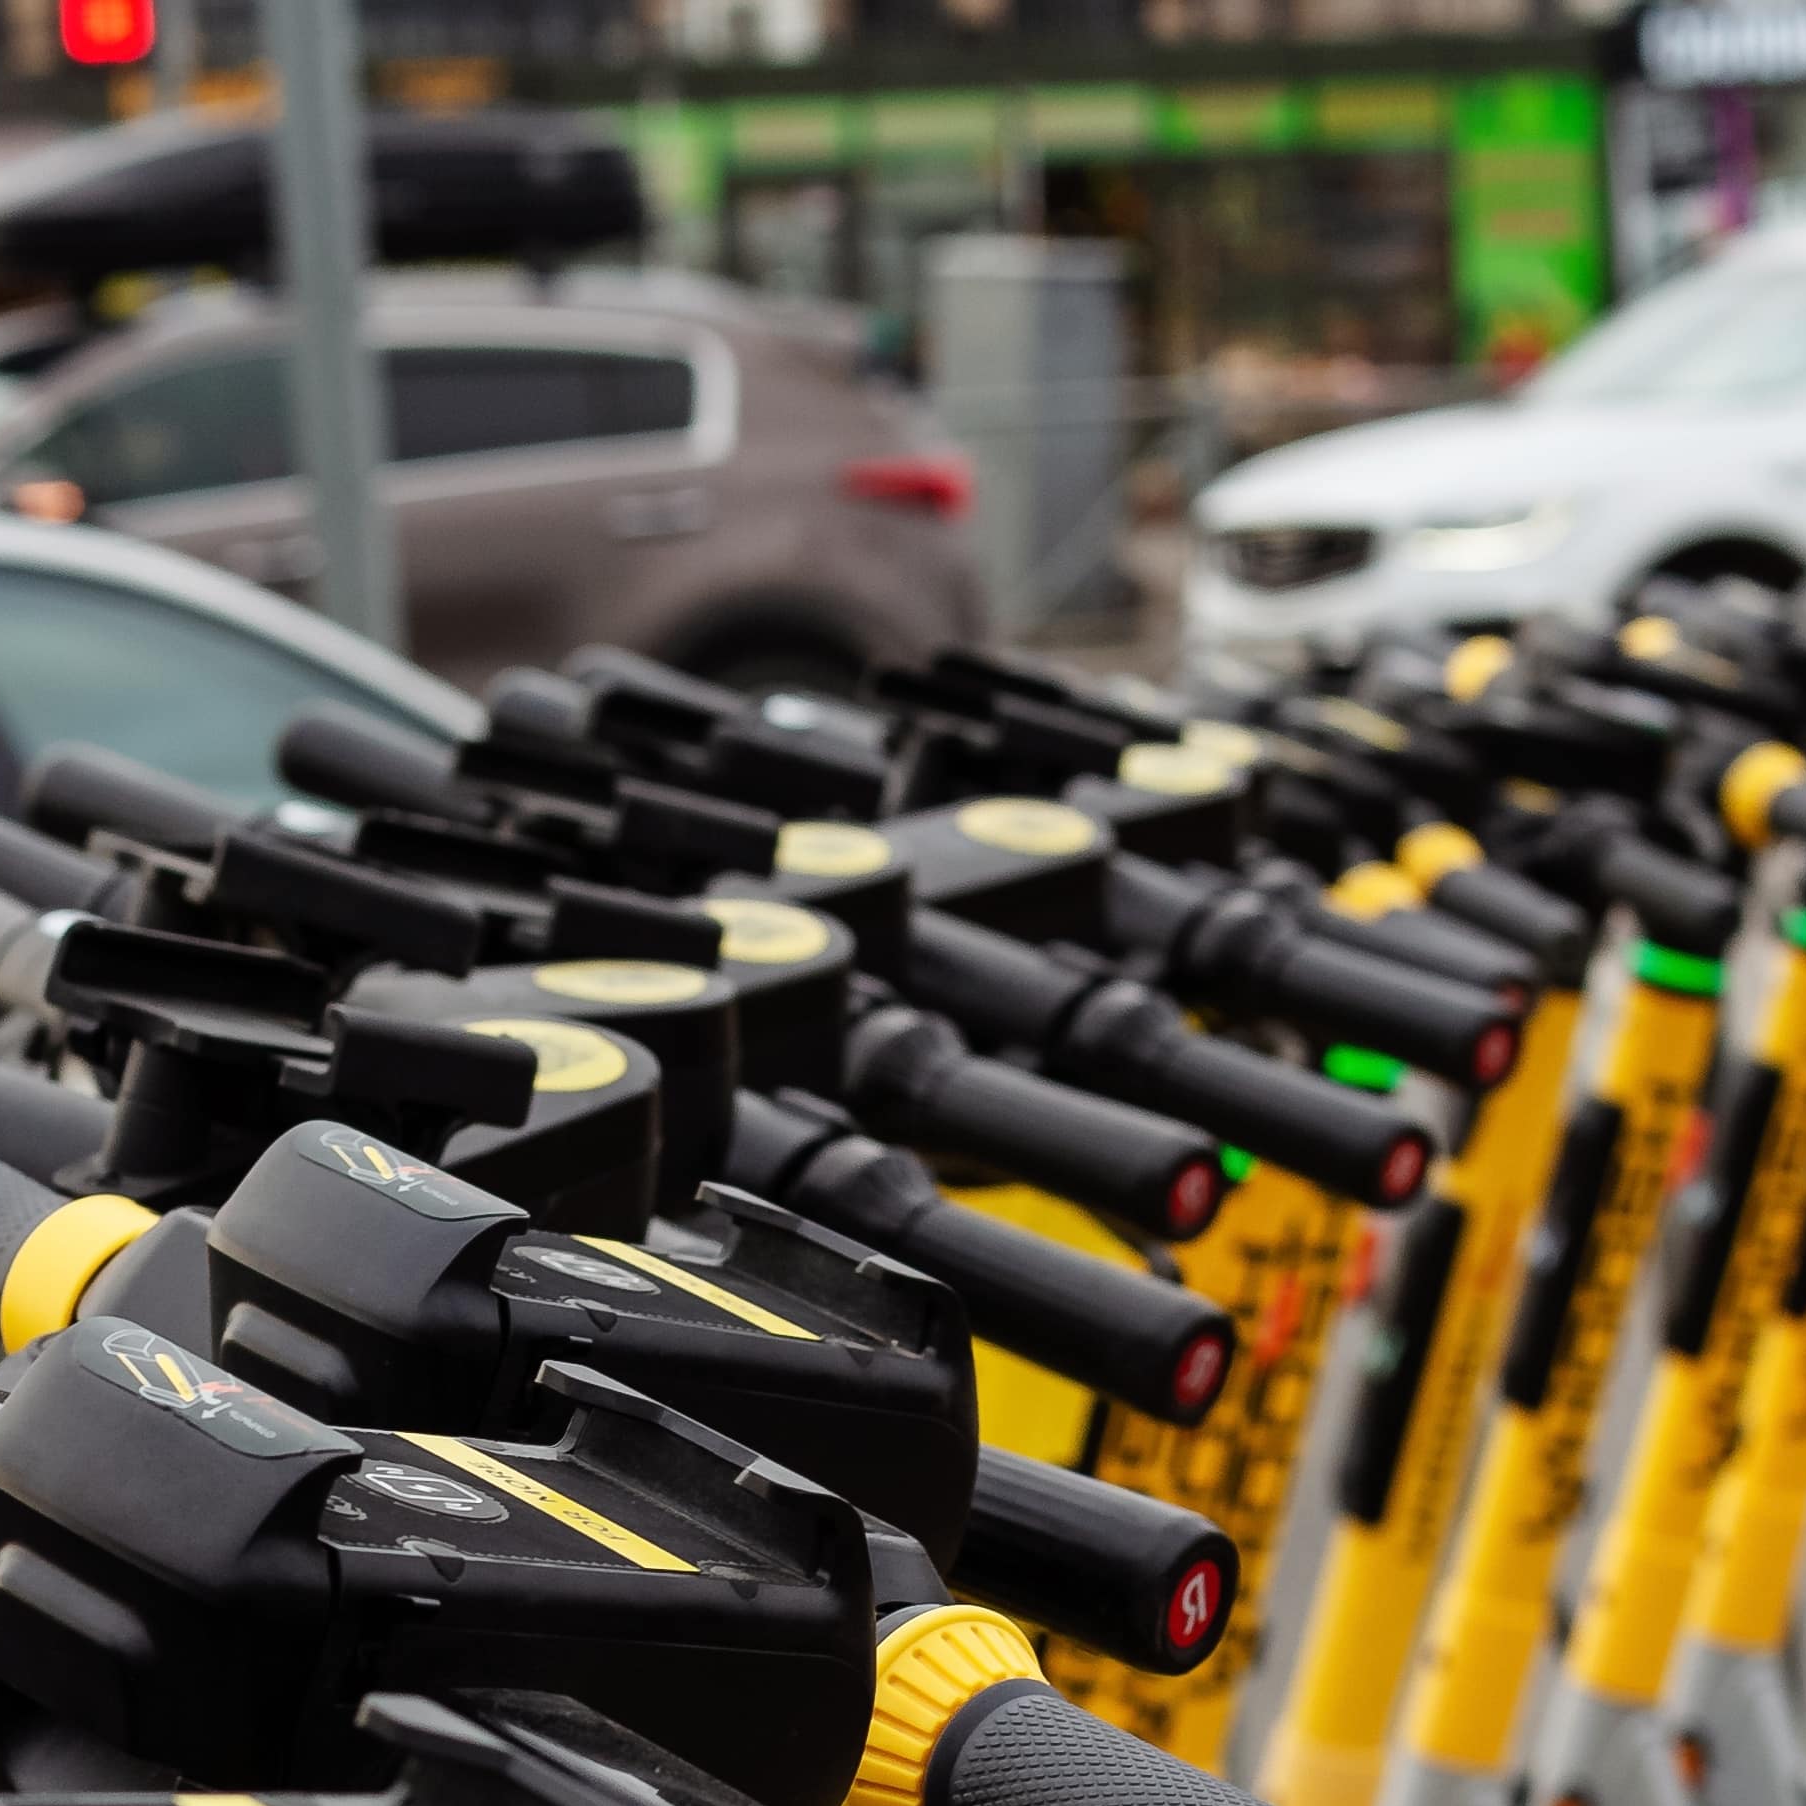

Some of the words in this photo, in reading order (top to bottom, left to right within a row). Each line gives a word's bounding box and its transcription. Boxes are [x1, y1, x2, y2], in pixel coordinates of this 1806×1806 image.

[466, 1459, 558, 1504] MORE
[562, 1509, 627, 1542] FOR
[1182, 1572, 1208, 1636] Я
